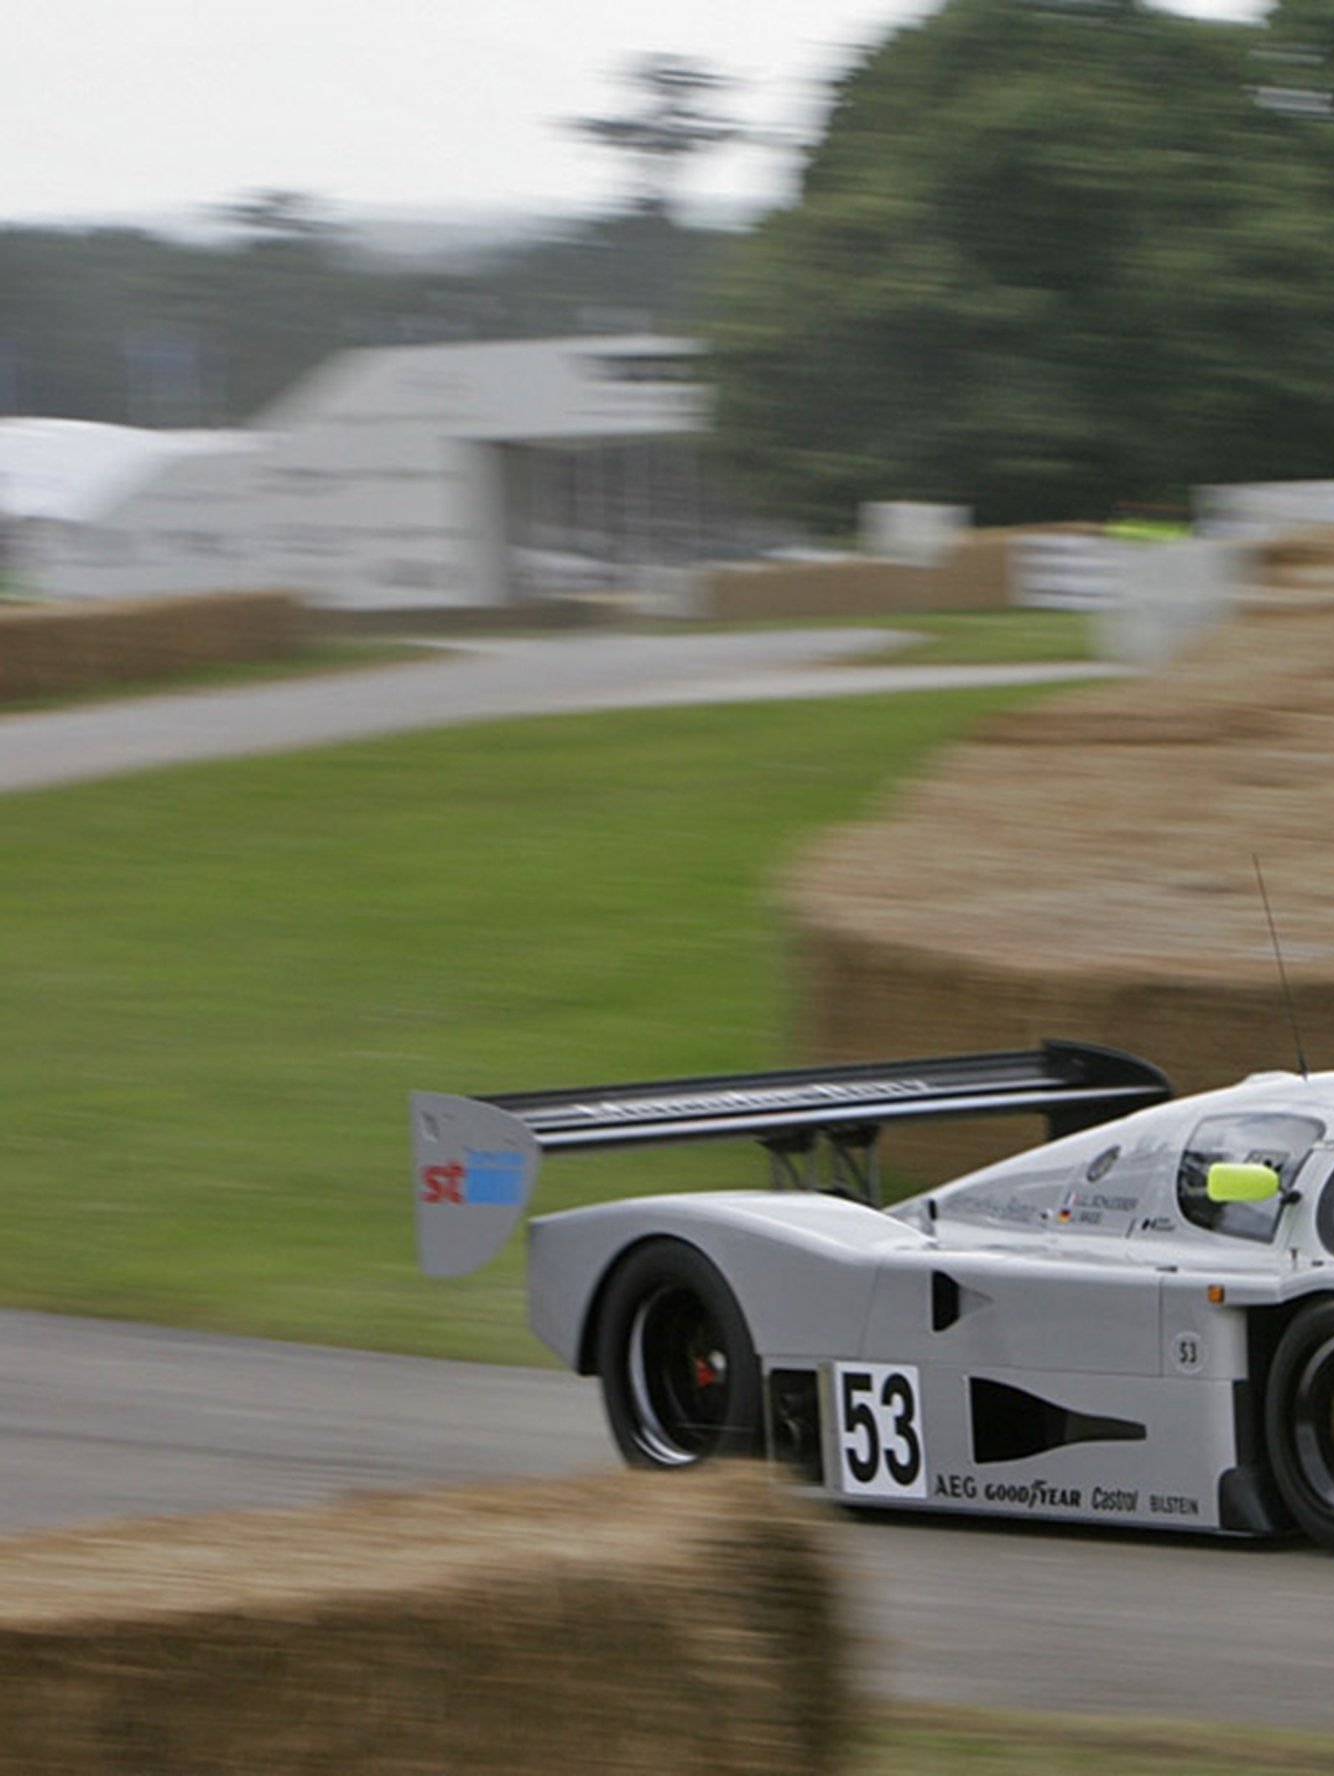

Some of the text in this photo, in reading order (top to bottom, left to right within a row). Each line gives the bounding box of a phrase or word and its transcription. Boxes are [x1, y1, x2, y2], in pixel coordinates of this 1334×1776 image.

[1179, 1340, 1198, 1363] 53
[842, 1372, 921, 1486] 53
[935, 1474, 978, 1499] AEG
[1091, 1486, 1139, 1511] Castrol
[1150, 1494, 1199, 1515] BILSTEIN
